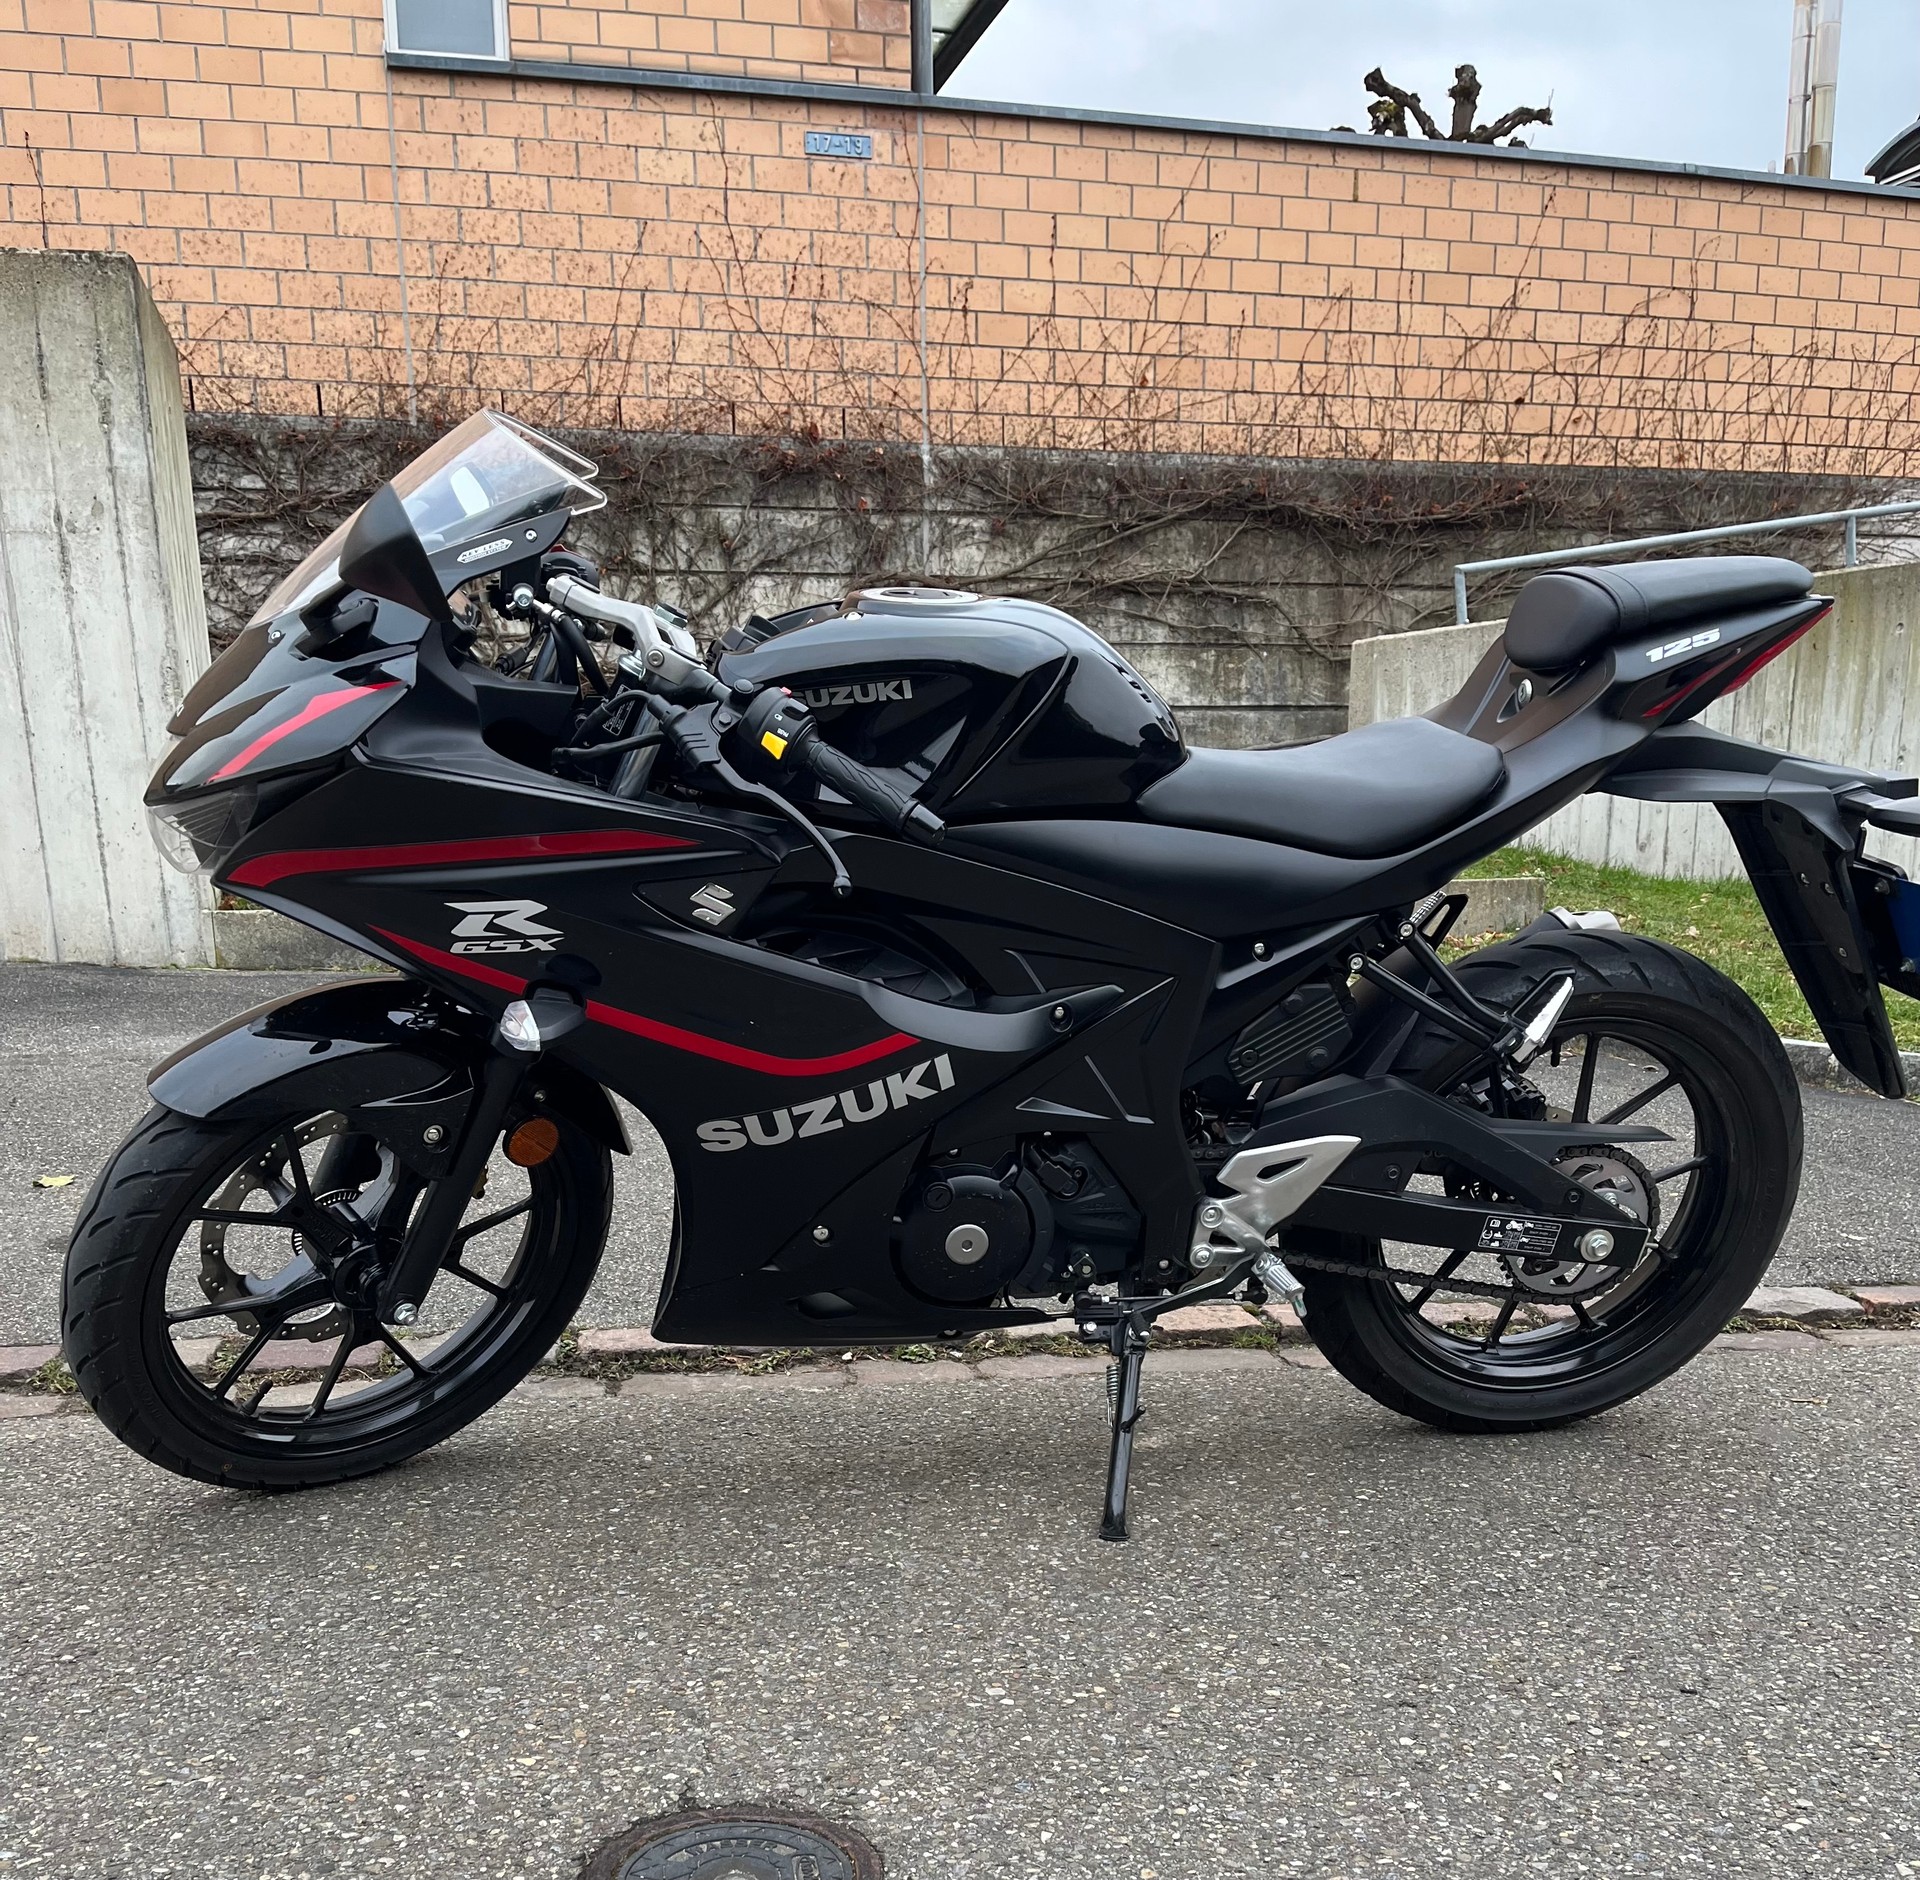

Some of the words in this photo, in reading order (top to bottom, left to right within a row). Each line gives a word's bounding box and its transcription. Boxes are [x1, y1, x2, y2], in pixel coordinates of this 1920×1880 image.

[813, 134, 863, 155] 17-19
[1645, 628, 1721, 662] 125
[443, 899, 565, 938] R
[449, 937, 565, 954] GSX
[696, 1052, 956, 1152] SUZUKI
